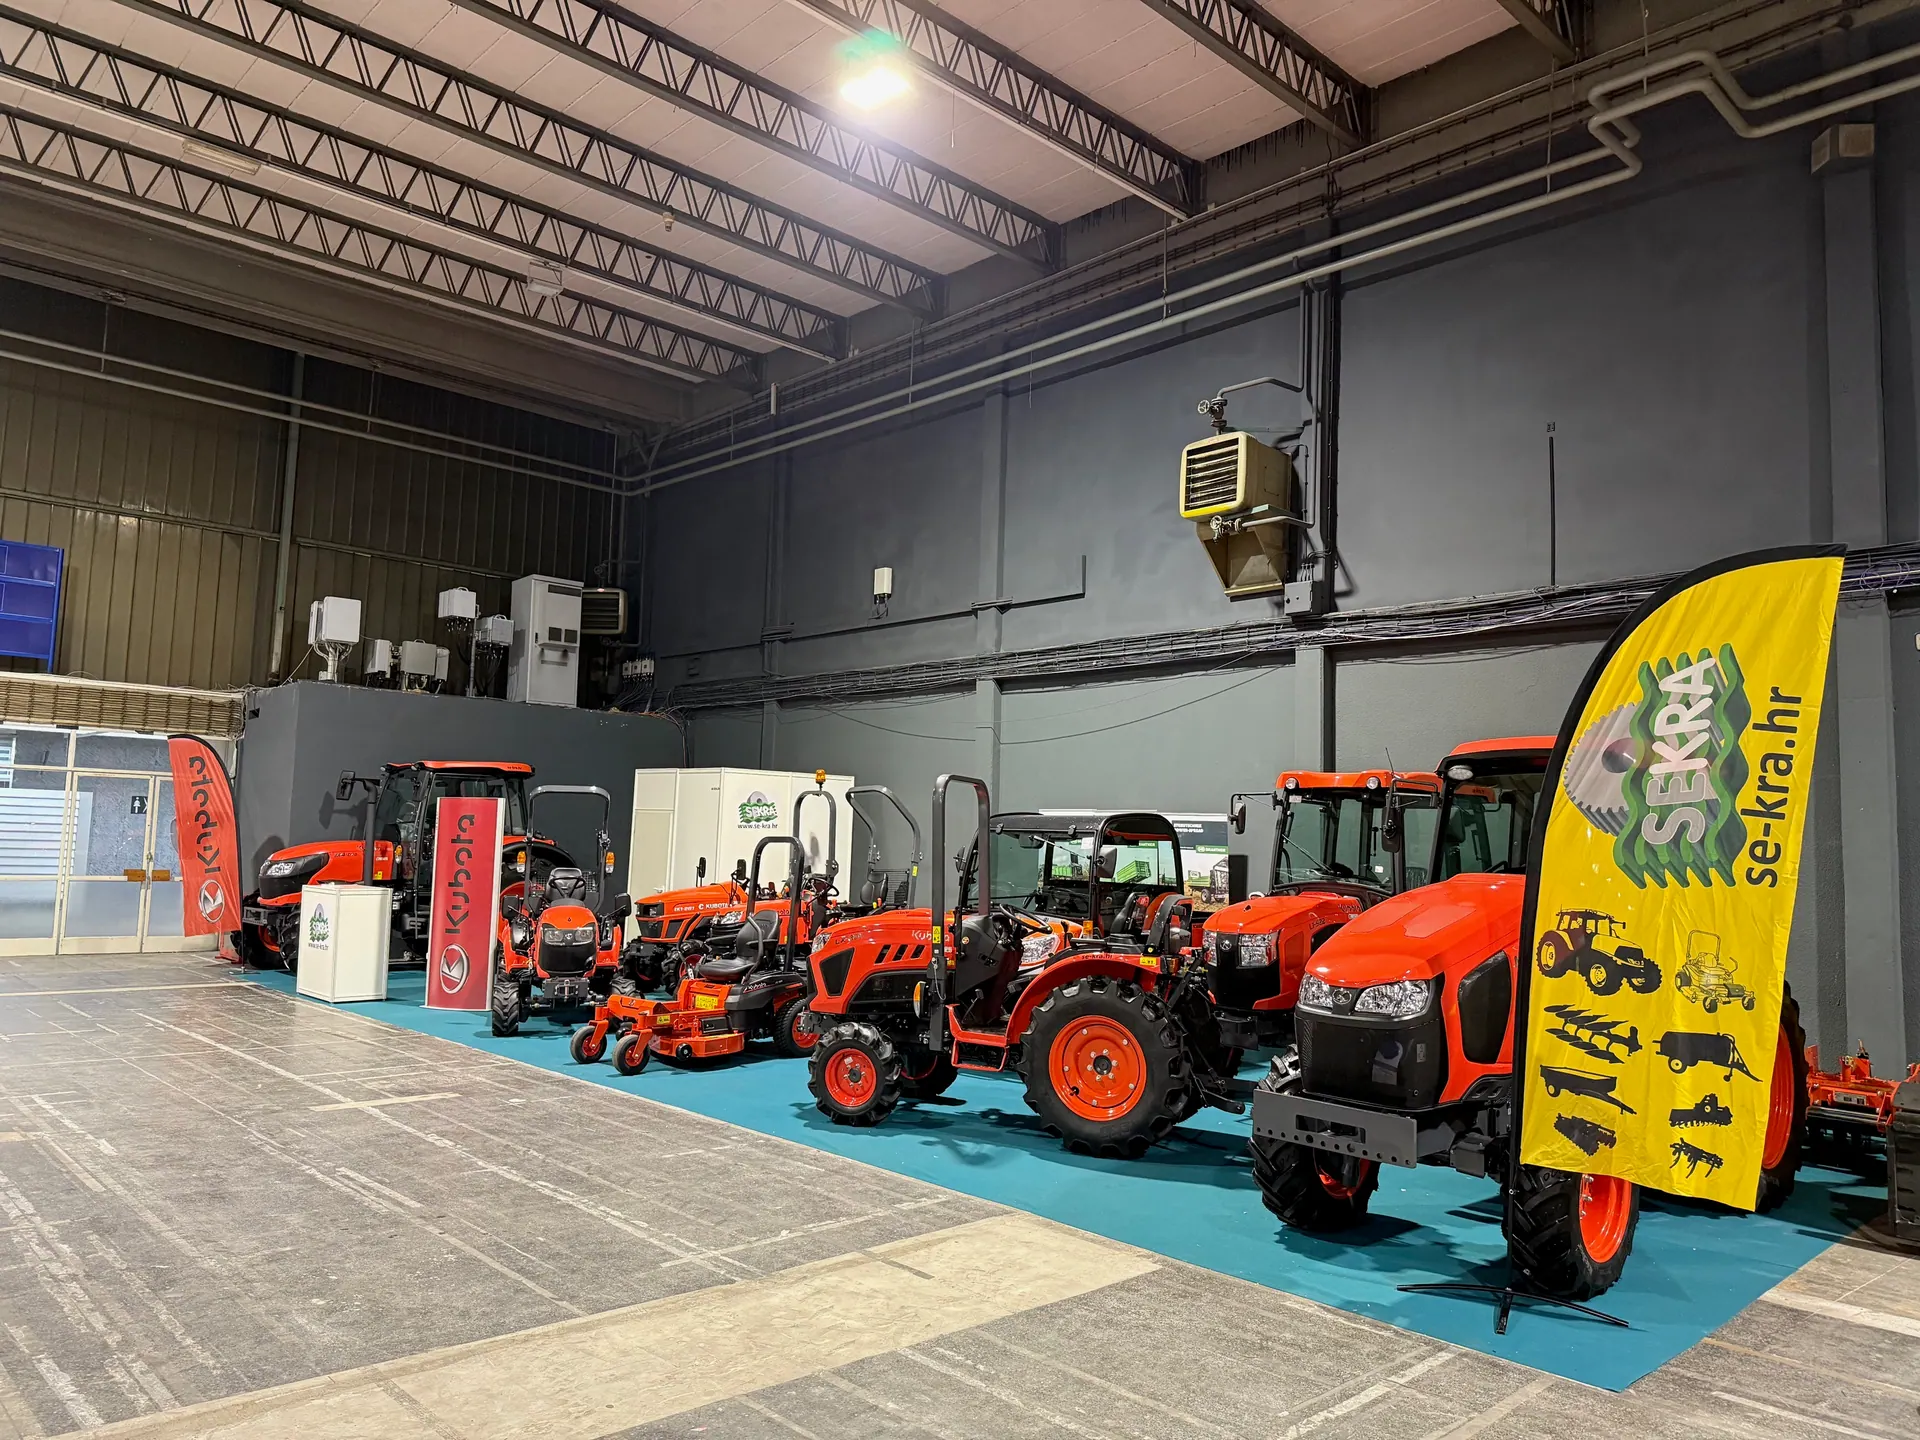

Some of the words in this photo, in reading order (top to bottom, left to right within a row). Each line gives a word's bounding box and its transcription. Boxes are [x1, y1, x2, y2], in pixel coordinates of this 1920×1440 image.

[1641, 657, 1717, 845] SEKRA
[1740, 686, 1802, 888] se-kra.hr
[745, 805, 776, 818] SEKRA
[444, 814, 475, 934] Kubota
[912, 930, 950, 942] Kuba
